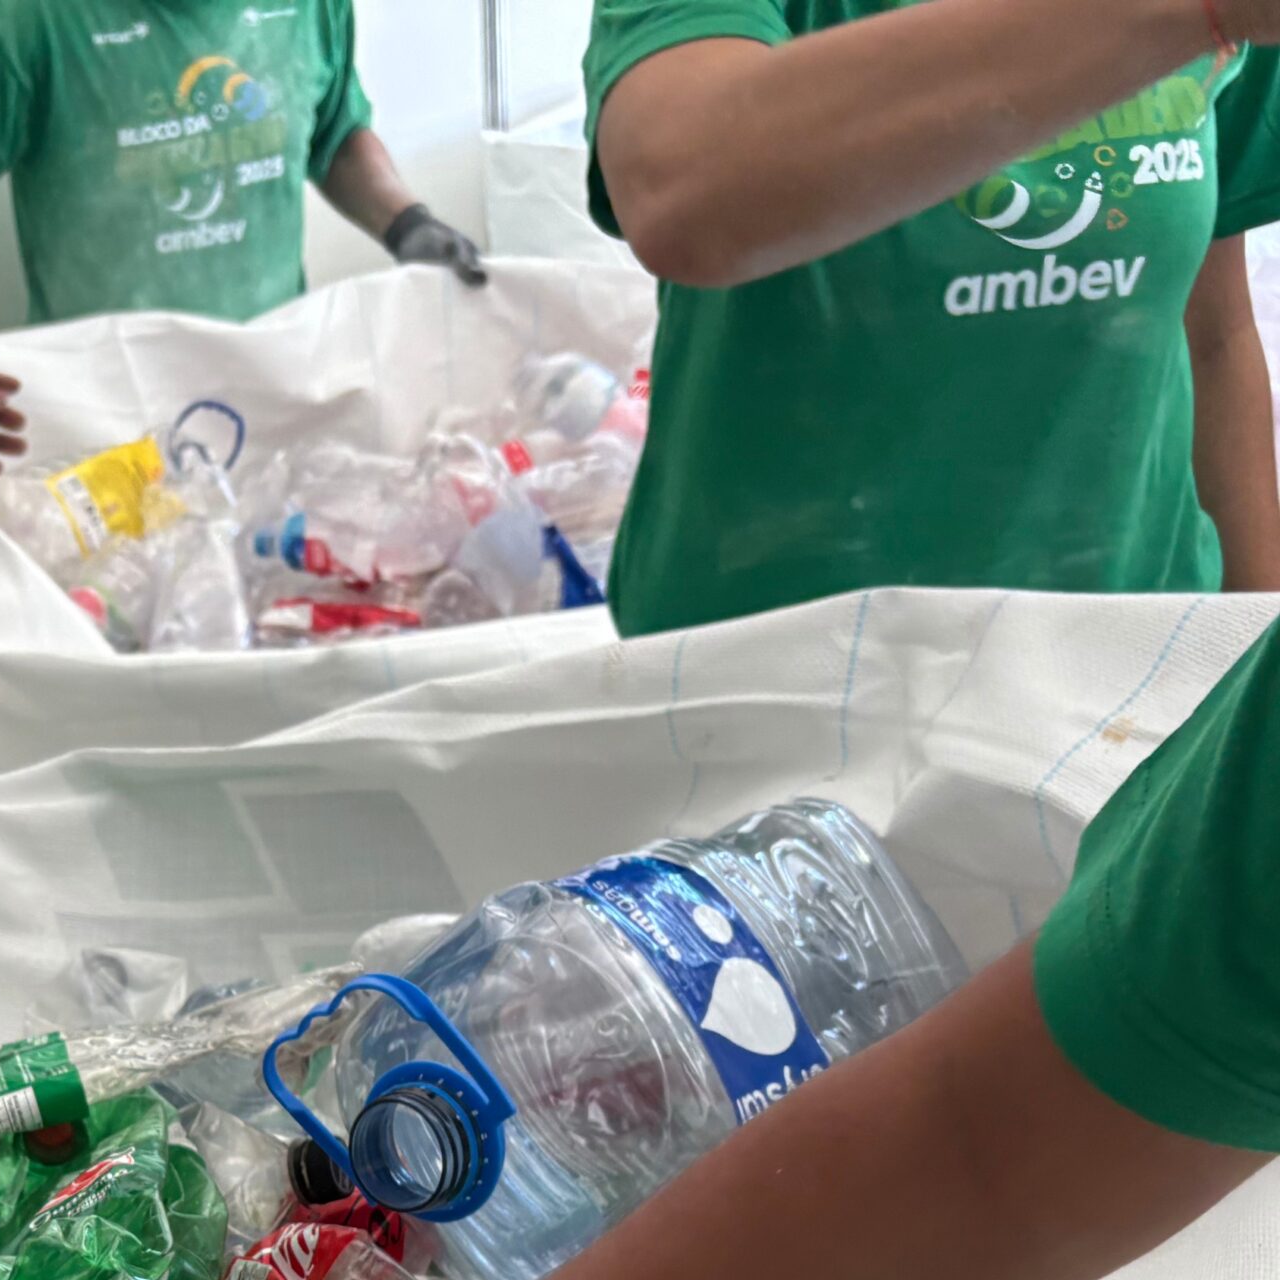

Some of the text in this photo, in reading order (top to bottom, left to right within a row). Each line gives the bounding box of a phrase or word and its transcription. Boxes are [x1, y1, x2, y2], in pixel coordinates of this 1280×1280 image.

[117, 119, 181, 147] BLOCO
[1129, 139, 1204, 185] 2025
[155, 220, 246, 253] ambev
[944, 254, 1146, 316] ambev
